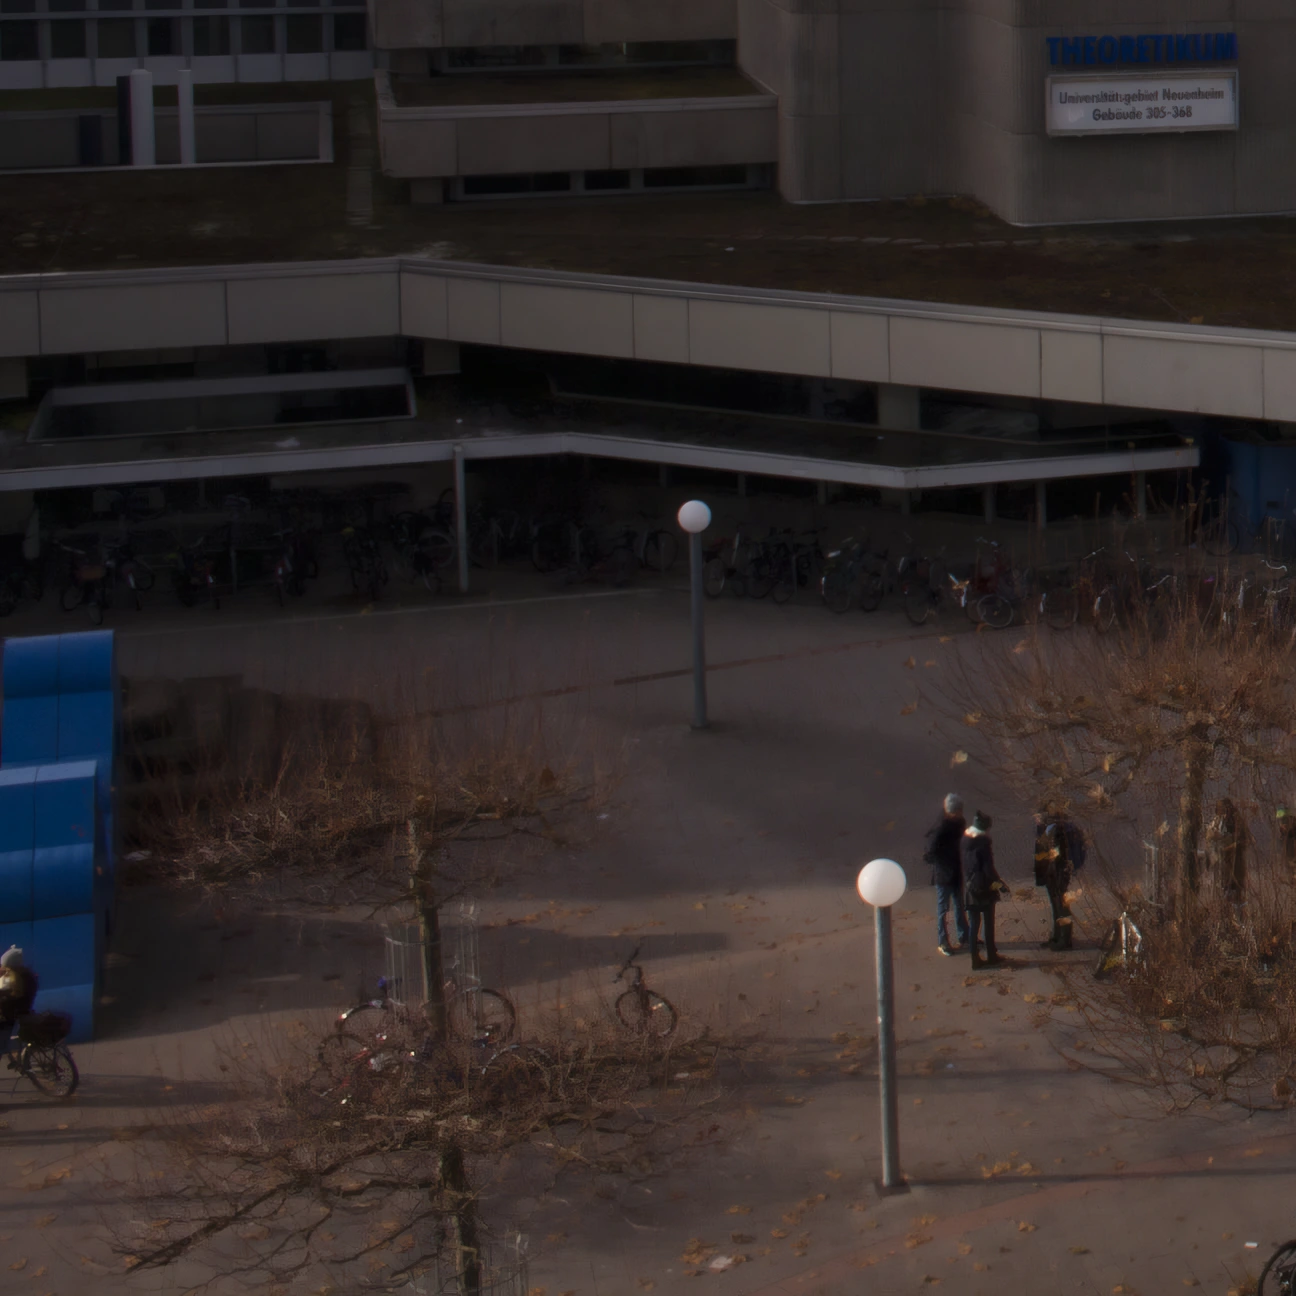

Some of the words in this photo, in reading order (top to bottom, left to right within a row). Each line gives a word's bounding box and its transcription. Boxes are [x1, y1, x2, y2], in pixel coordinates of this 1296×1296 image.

[1046, 33, 1238, 65] THEORETIKUM
[1162, 87, 1225, 101] Neuenheim
[1092, 107, 1143, 121] Gebäude
[1146, 105, 1193, 120] 305-368
